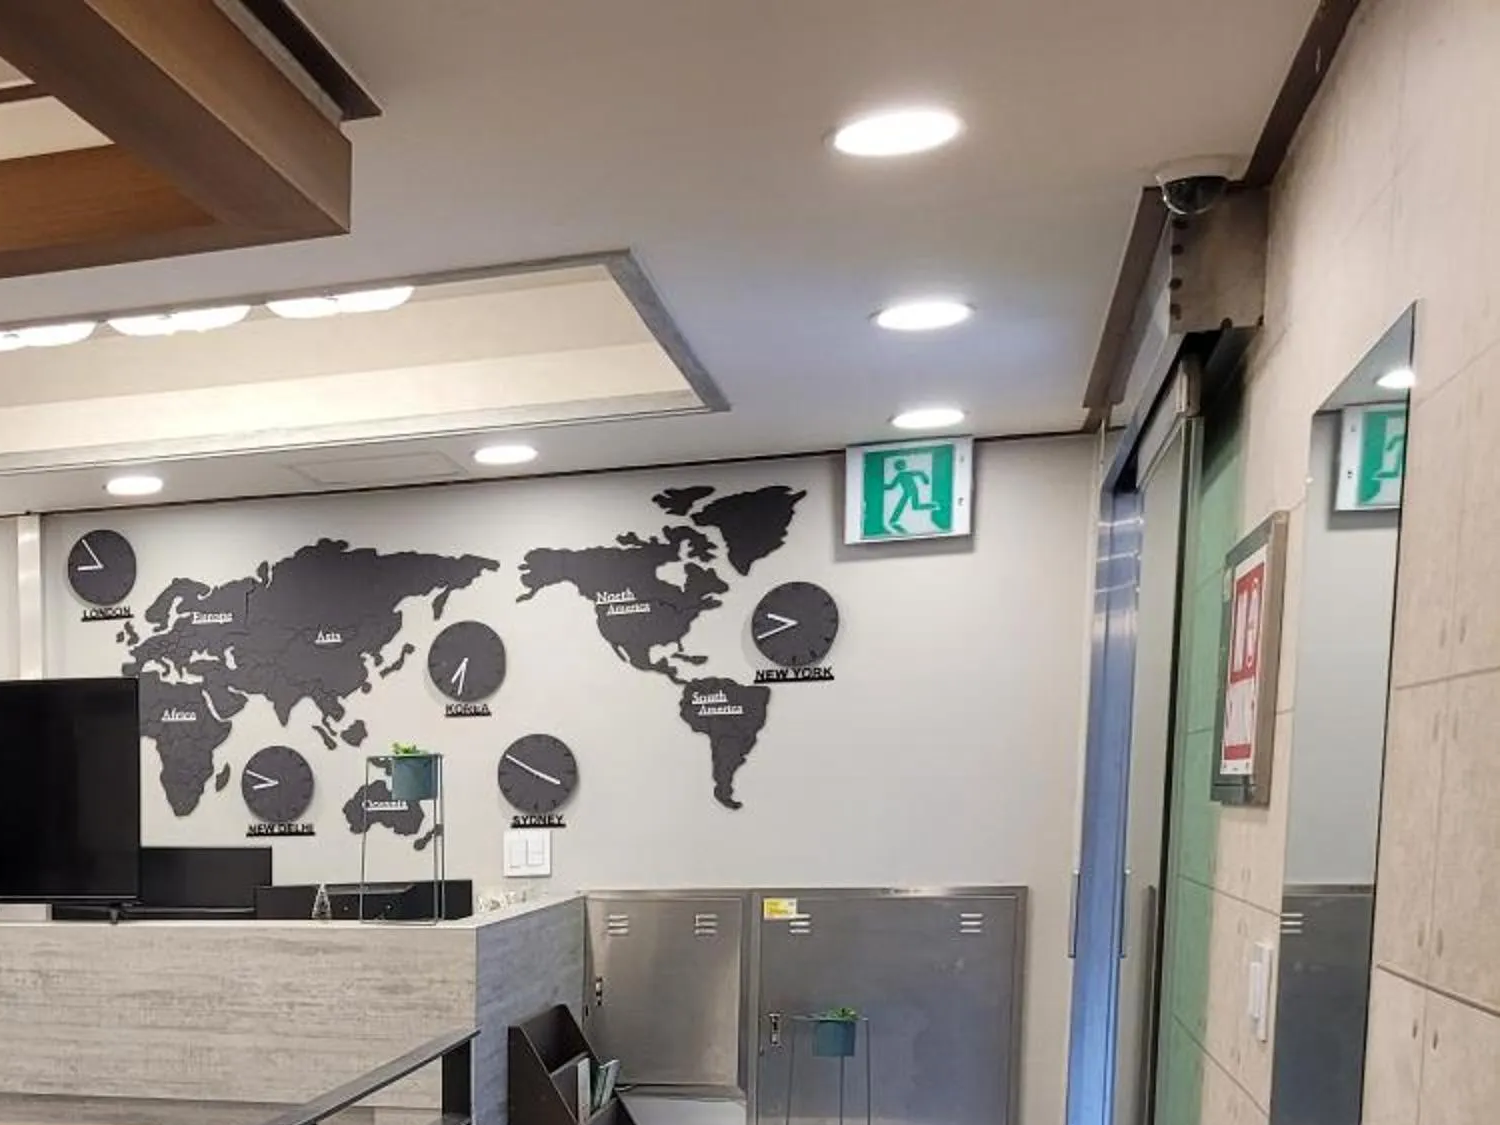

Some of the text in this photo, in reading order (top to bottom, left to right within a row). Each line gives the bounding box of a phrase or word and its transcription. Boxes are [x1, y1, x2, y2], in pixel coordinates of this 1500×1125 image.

[315, 630, 342, 644] Asia
[755, 666, 834, 683] NEW YORK
[692, 690, 728, 704] South
[161, 708, 197, 721] Africa
[698, 705, 743, 716] America
[511, 814, 566, 828] SYDNEY
[247, 823, 274, 837] NEW
